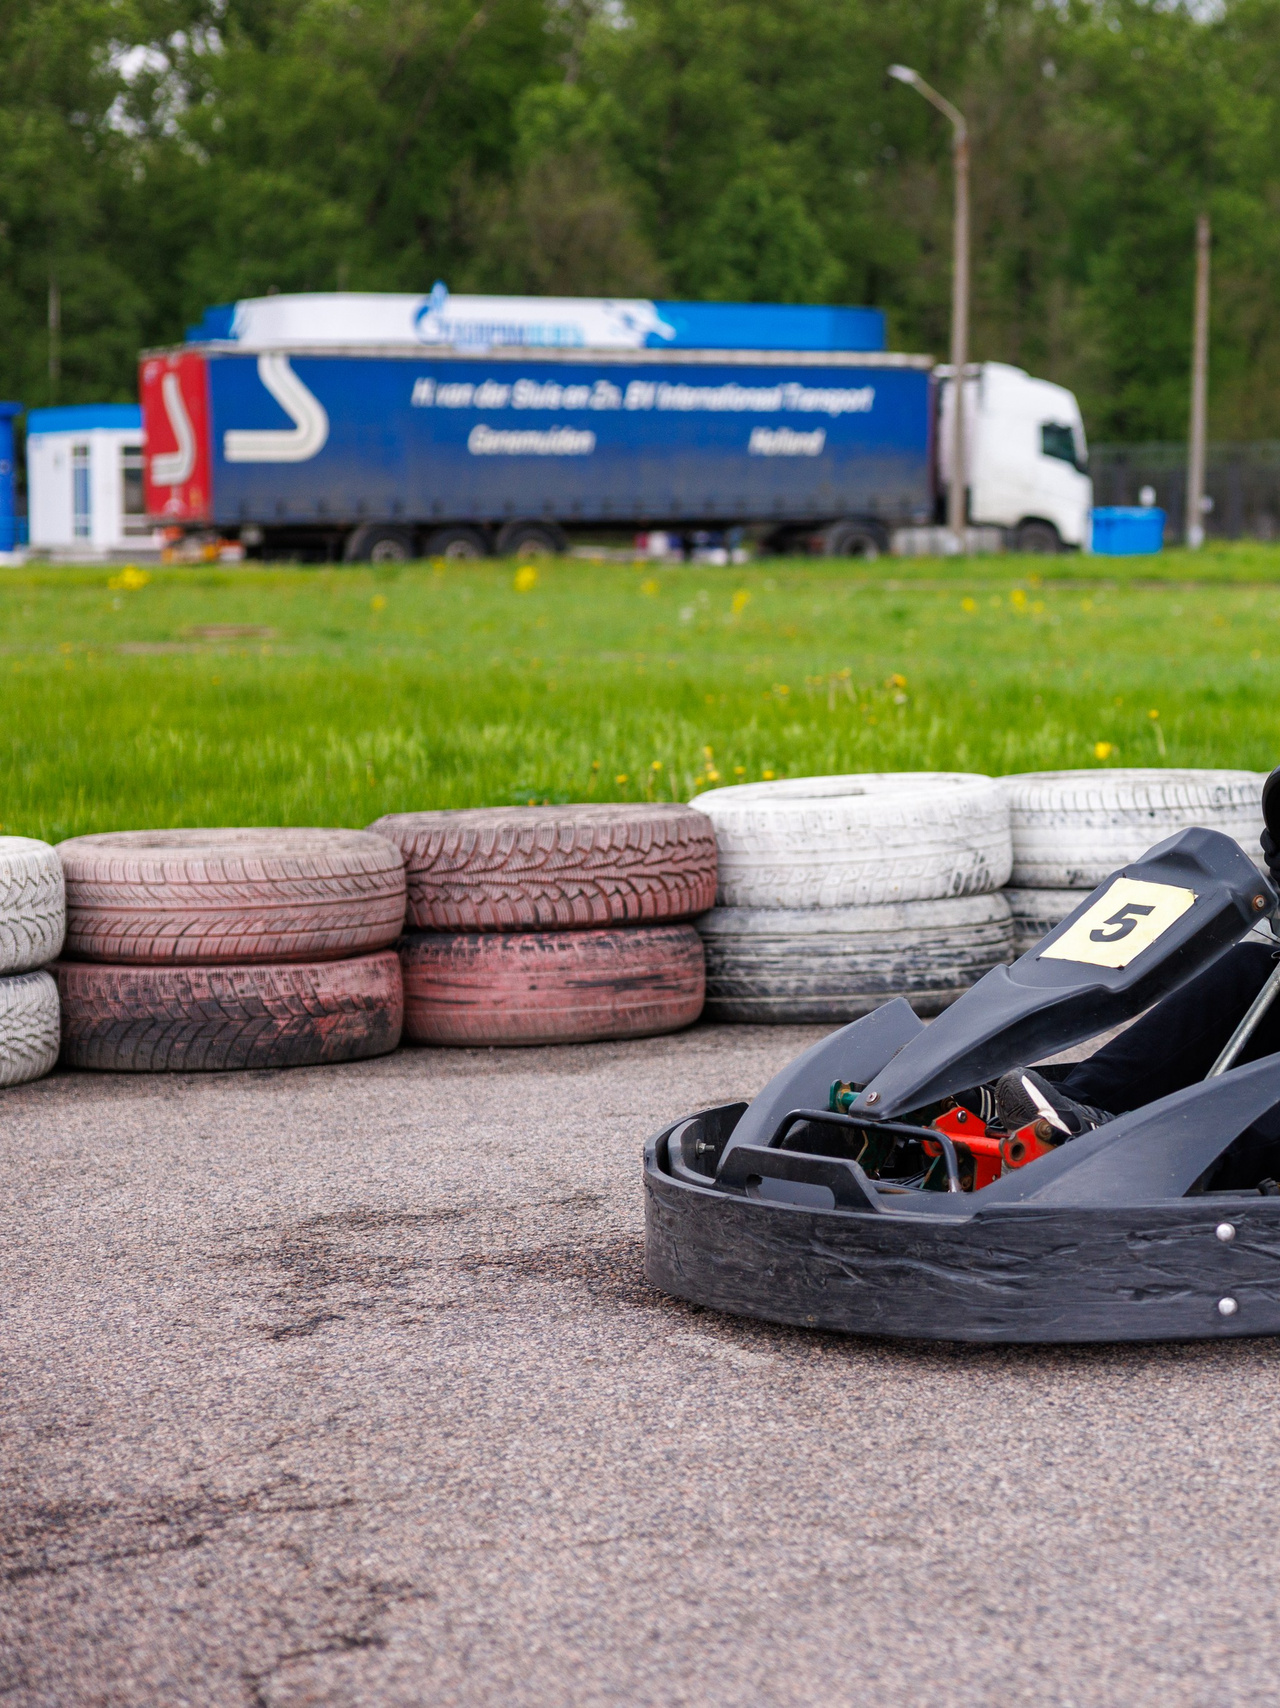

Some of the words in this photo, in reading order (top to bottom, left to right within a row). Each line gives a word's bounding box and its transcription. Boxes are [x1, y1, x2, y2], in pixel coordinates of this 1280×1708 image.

[437, 383, 474, 408] van
[474, 379, 511, 409] der
[783, 382, 875, 417] Transport
[748, 426, 826, 456] Holland
[1089, 902, 1156, 943] 5
